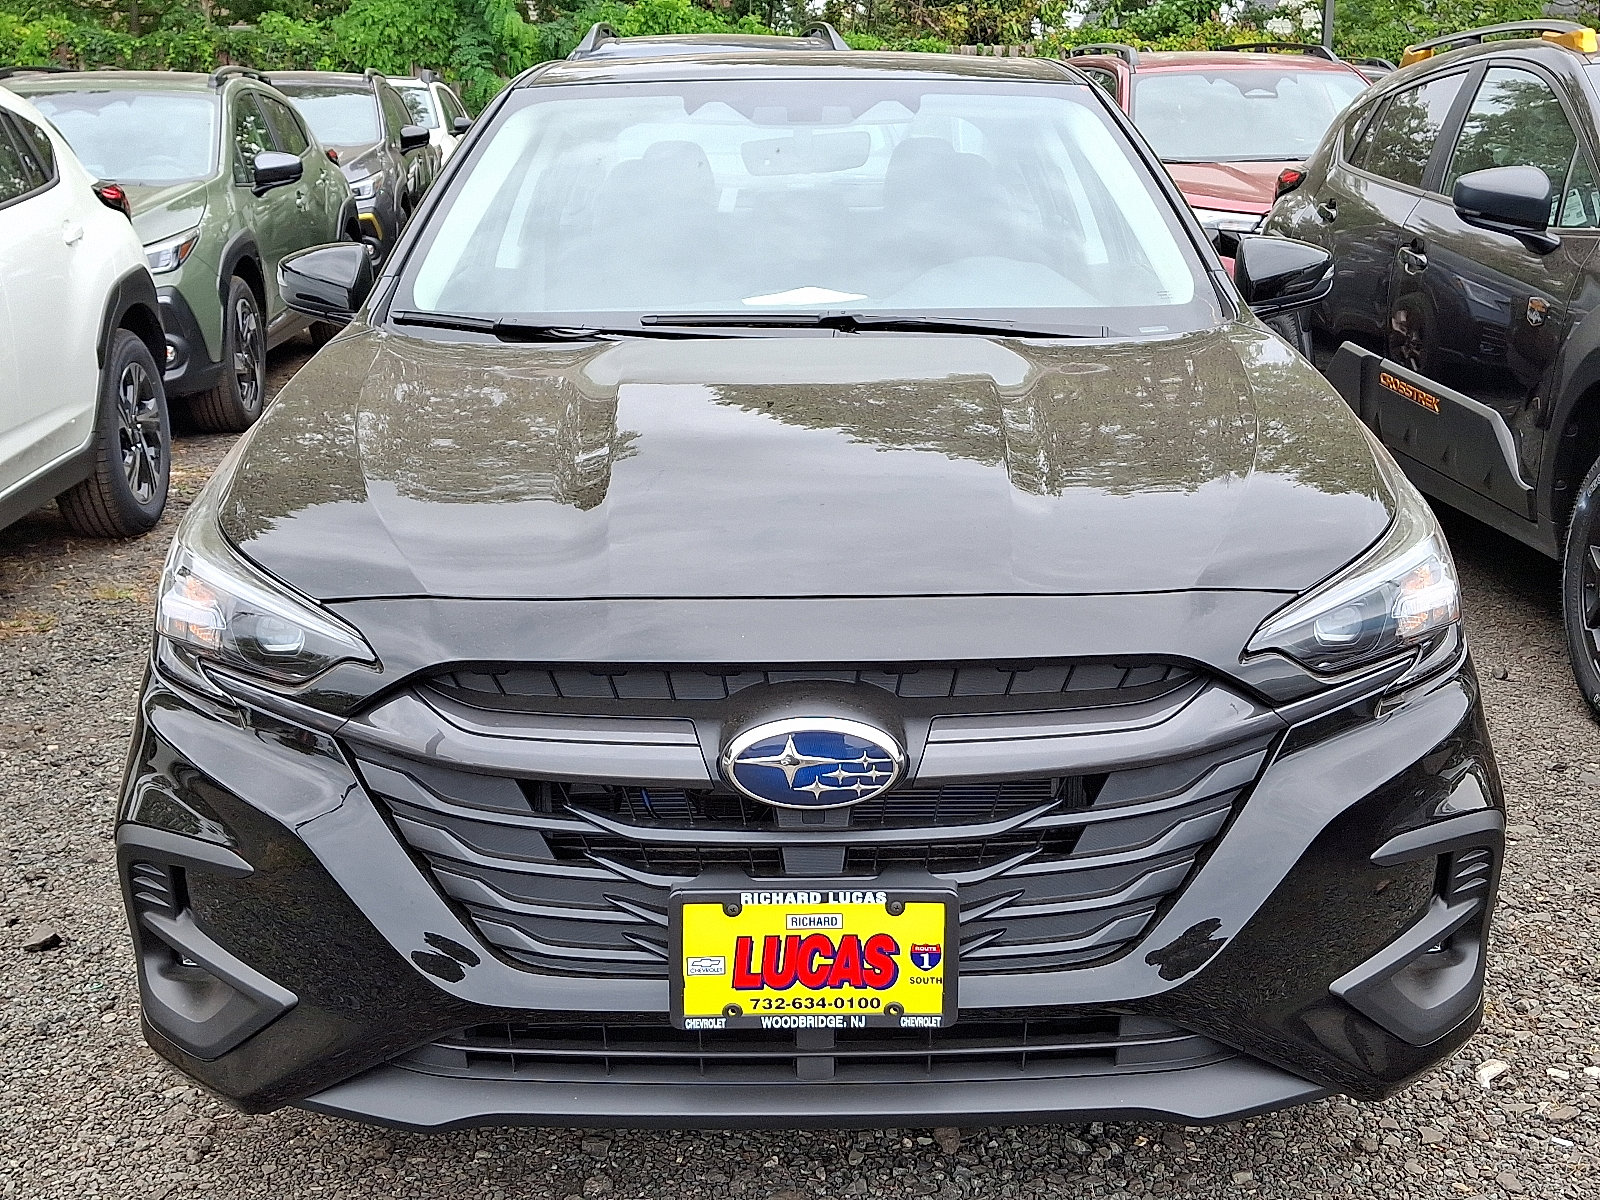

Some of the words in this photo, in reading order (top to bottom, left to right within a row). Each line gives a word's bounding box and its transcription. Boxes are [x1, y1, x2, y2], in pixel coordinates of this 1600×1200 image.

[1380, 372, 1440, 412] CROSSTREK
[741, 892, 821, 904] RICHARD
[828, 892, 887, 904] LUCAS
[790, 917, 838, 927] RICHARD
[731, 933, 900, 991] LUCAS
[920, 953, 932, 969] 1
[750, 997, 881, 1009] 732-634-0100
[685, 1018, 726, 1029] CHEVROLET
[761, 1016, 847, 1028] WOODBRIDGE,
[851, 1016, 865, 1027] NJ
[900, 1017, 941, 1027] CHEVROLET
